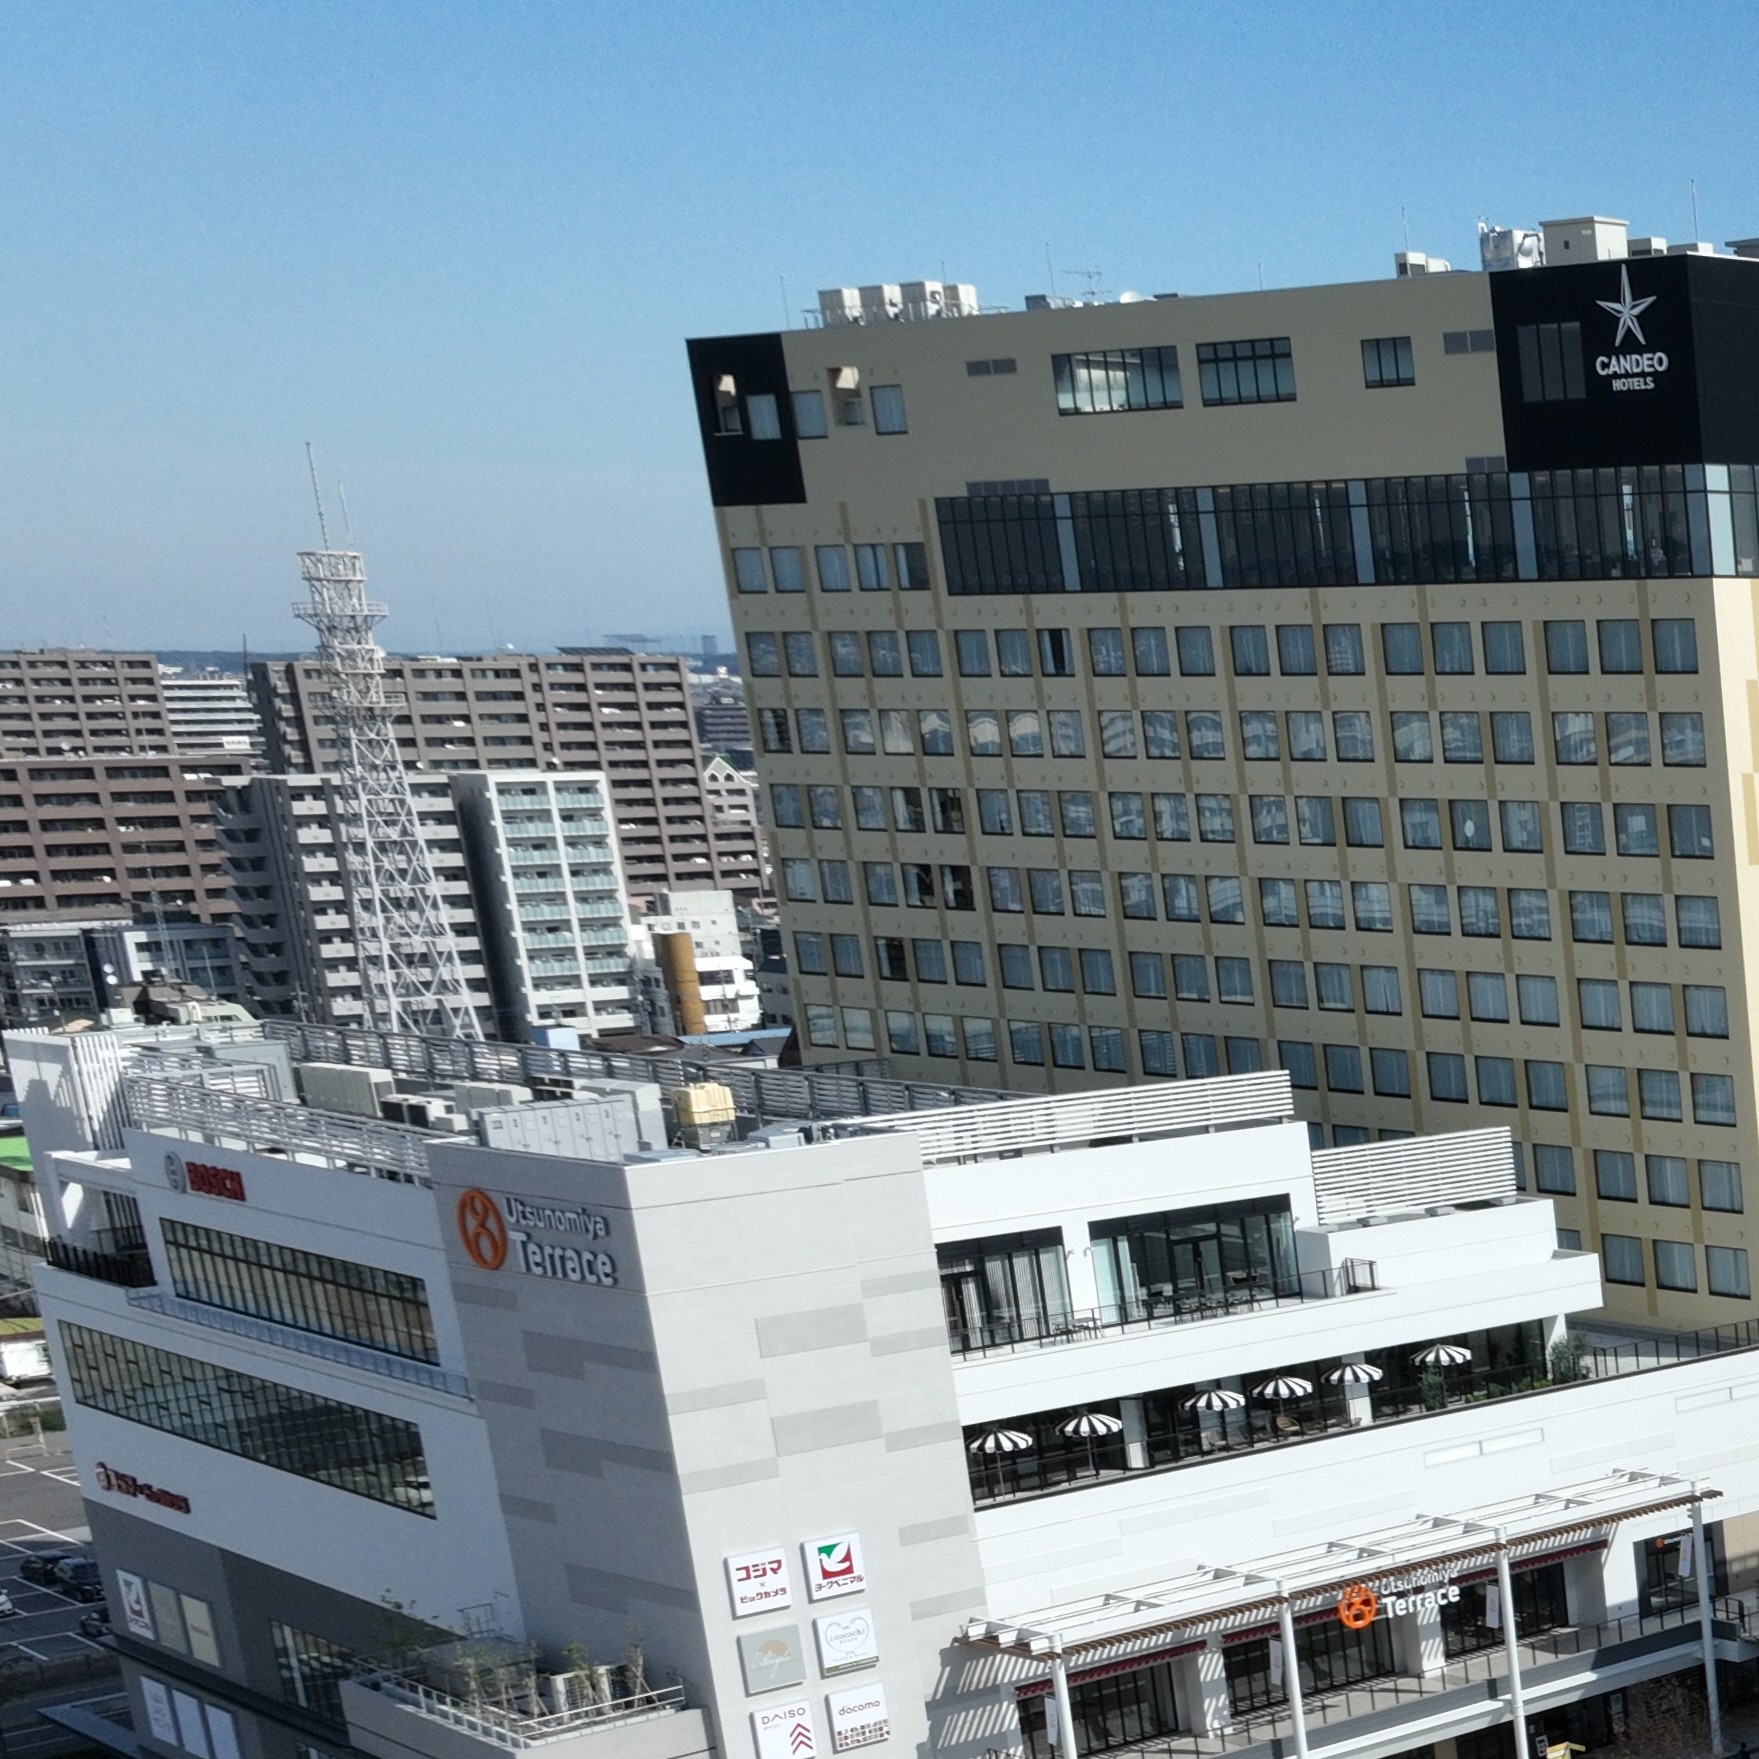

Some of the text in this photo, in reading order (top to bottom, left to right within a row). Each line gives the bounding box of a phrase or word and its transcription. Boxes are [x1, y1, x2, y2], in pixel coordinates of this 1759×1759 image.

[1596, 352, 1669, 376] CANDEO
[1612, 376, 1655, 391] HOTELS
[504, 1197, 610, 1241] Utsunomiya
[507, 1229, 618, 1287] Terrace
[735, 1558, 783, 1582] コジマ
[1380, 1566, 1459, 1595] Utsunomiya
[739, 1586, 788, 1604] ビックカメラ
[815, 1574, 865, 1593] ヨークベニマル
[1382, 1584, 1460, 1619] Terrace
[761, 1707, 806, 1725] DAISO
[838, 1699, 881, 1717] docomo
